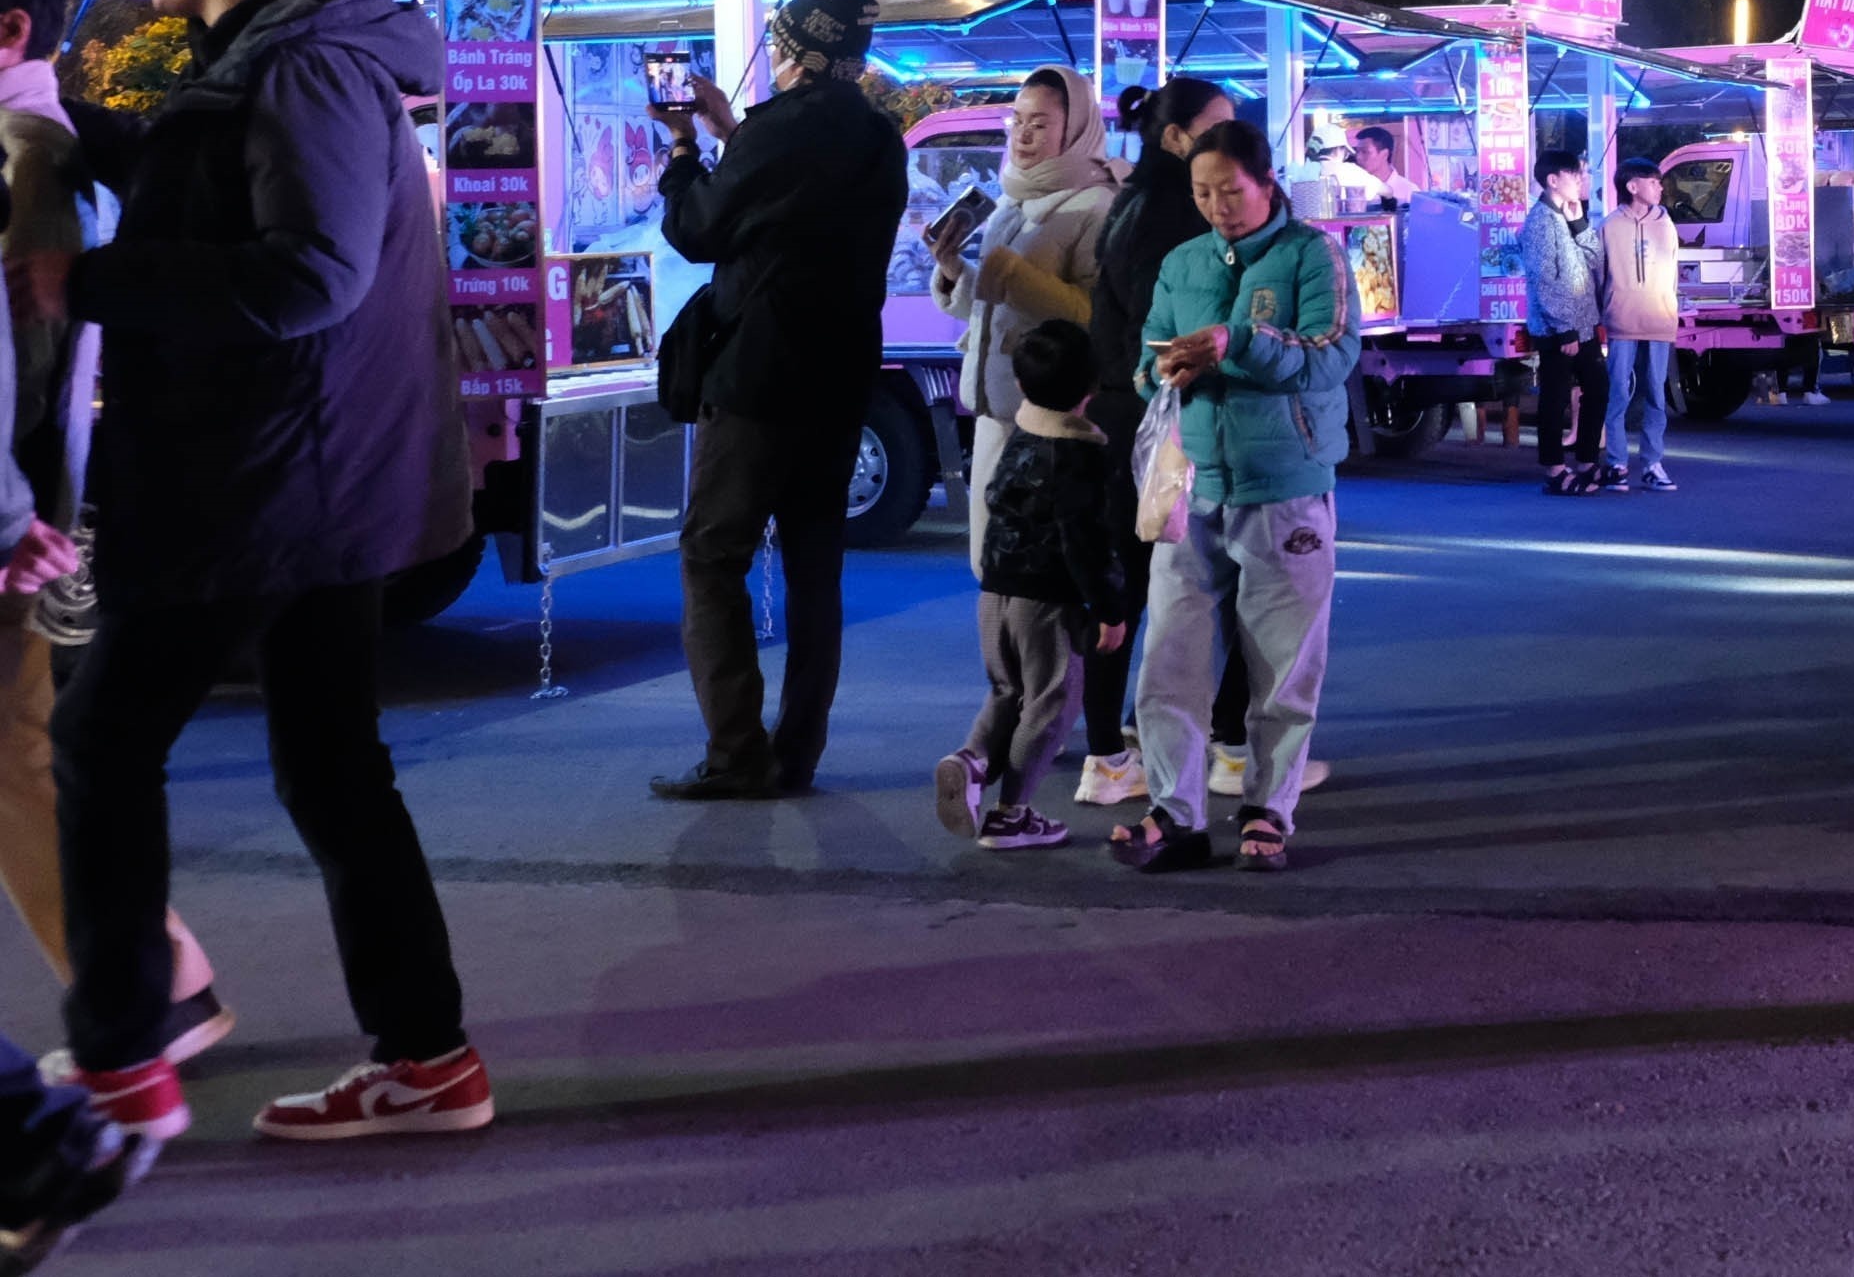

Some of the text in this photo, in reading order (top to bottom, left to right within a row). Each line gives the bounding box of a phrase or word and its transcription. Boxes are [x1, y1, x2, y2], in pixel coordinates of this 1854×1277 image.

[448, 49, 532, 69] Bánh Tráng
[478, 78, 496, 91] La
[500, 77, 528, 91] 30k
[454, 177, 528, 192] Khoai 30k
[1489, 227, 1518, 245] 50K
[454, 277, 529, 295] Trứng 10k
[1775, 289, 1809, 303] 150K
[1490, 301, 1518, 319] 50K
[495, 378, 523, 393] 15k
